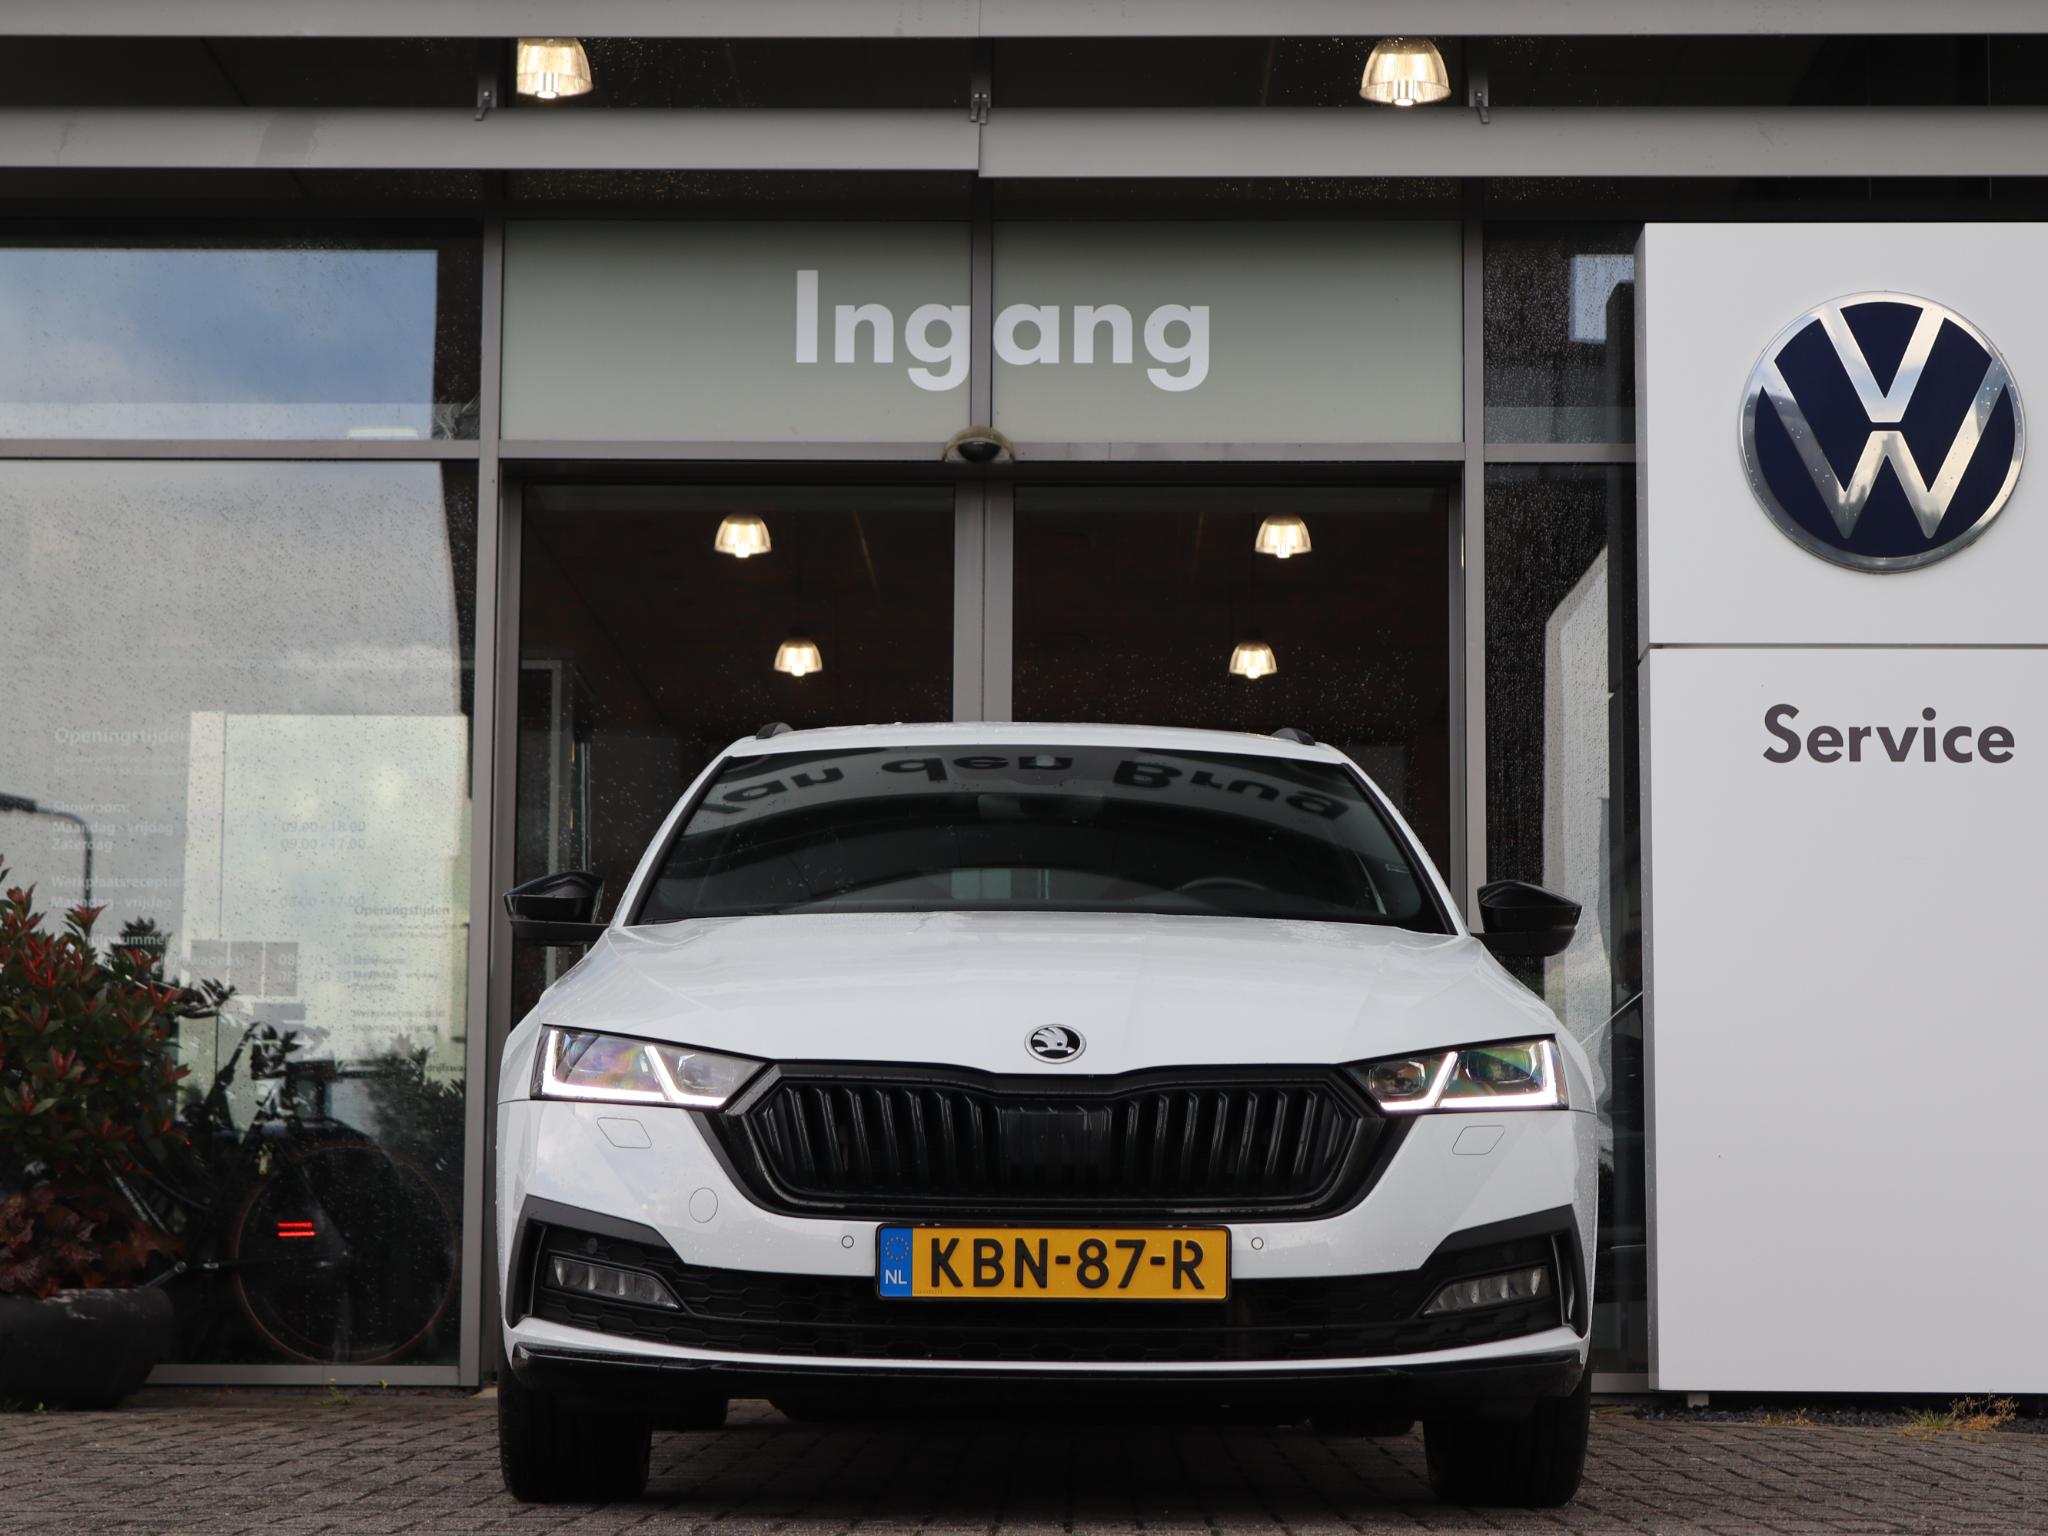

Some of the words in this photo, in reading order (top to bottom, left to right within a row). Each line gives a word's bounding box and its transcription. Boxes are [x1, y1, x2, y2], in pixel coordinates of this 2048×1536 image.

[795, 269, 1211, 392] Ingang
[1762, 703, 2016, 764] Service
[884, 1268, 908, 1286] NL
[929, 1236, 1205, 1291] KBN-87-R
